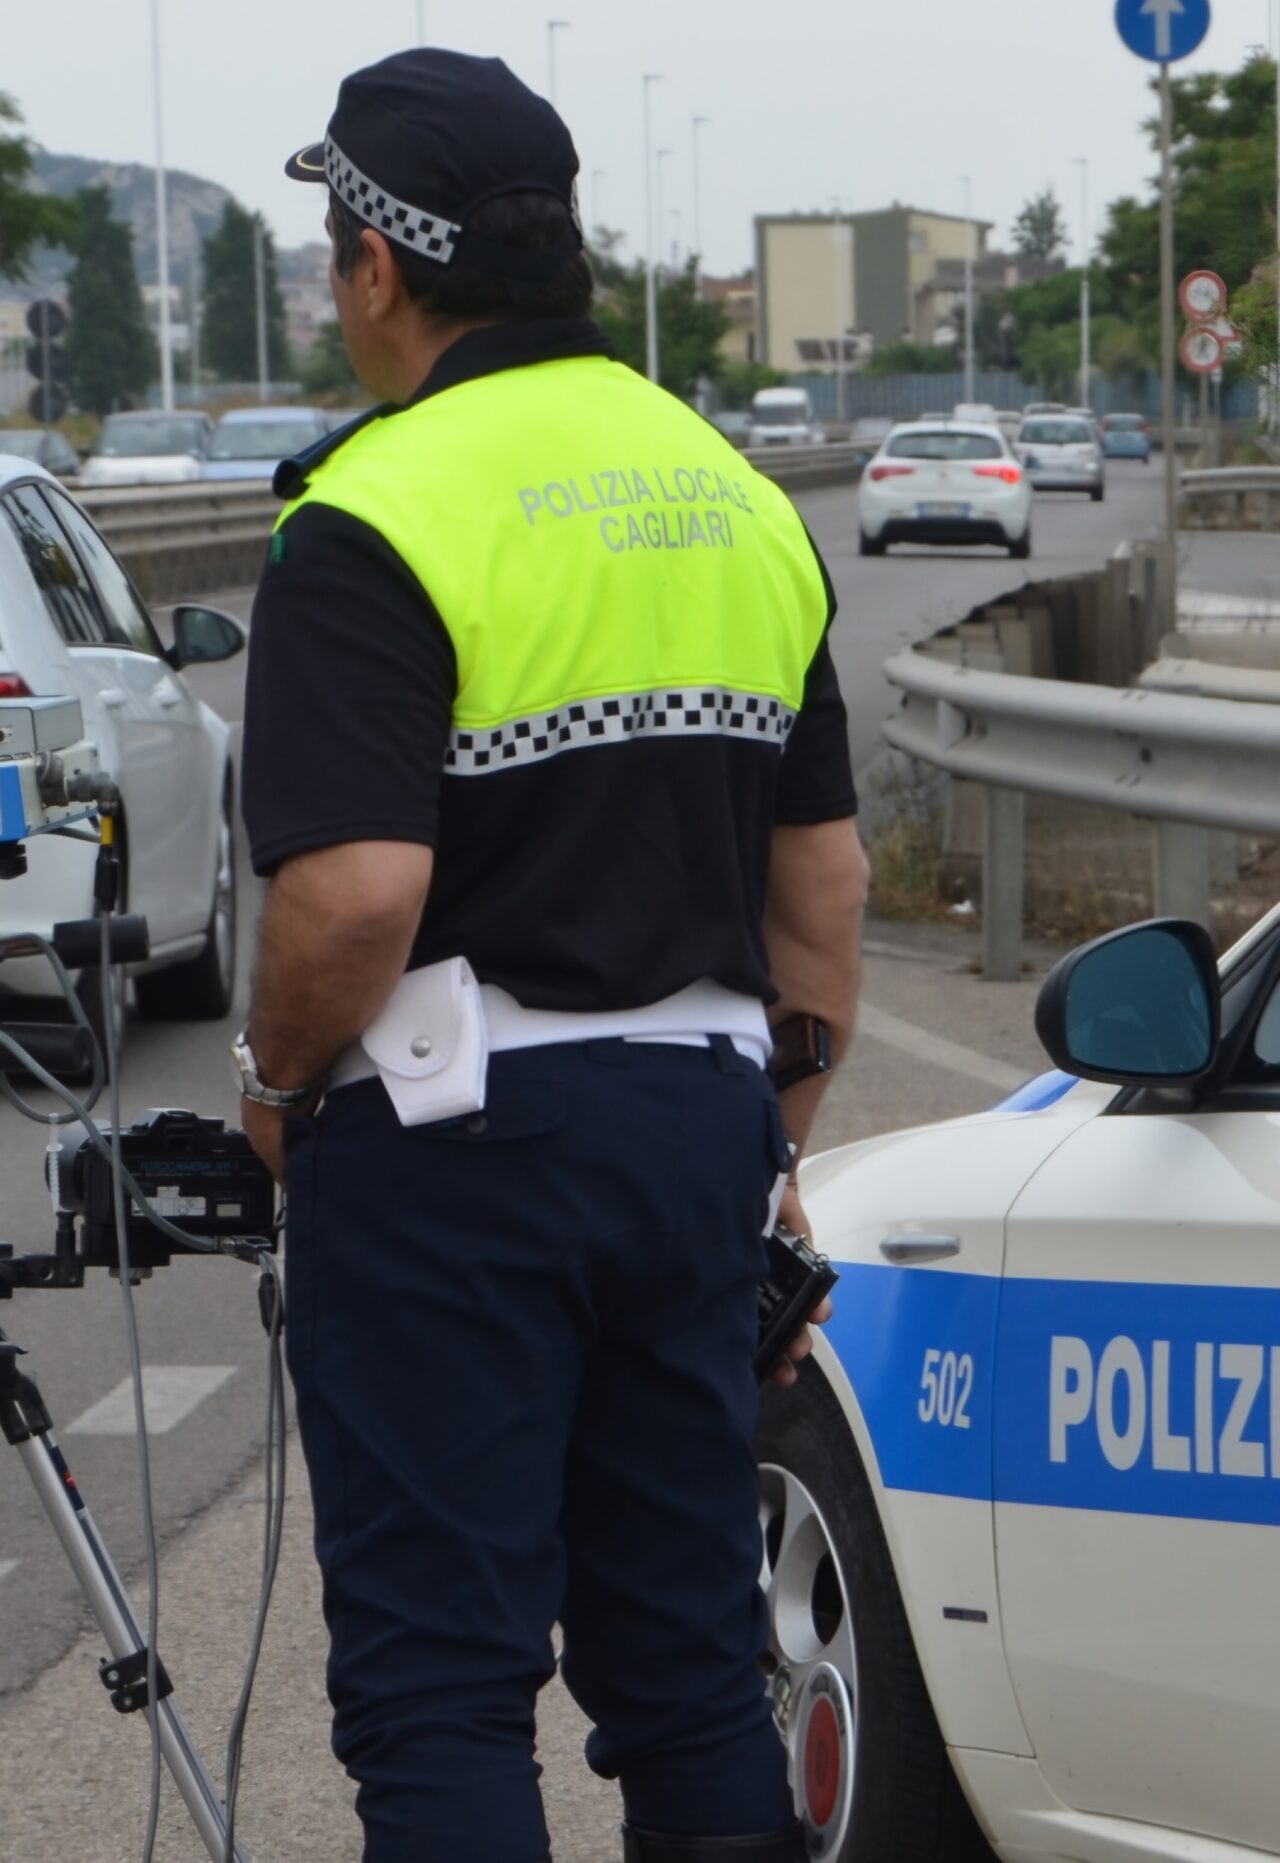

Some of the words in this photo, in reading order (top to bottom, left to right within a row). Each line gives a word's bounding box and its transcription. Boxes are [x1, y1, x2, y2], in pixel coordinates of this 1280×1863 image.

[517, 468, 655, 527] POLIZIA
[654, 467, 753, 514] LOCALE
[599, 510, 733, 553] CAGLIARI
[918, 1348, 973, 1429] 502
